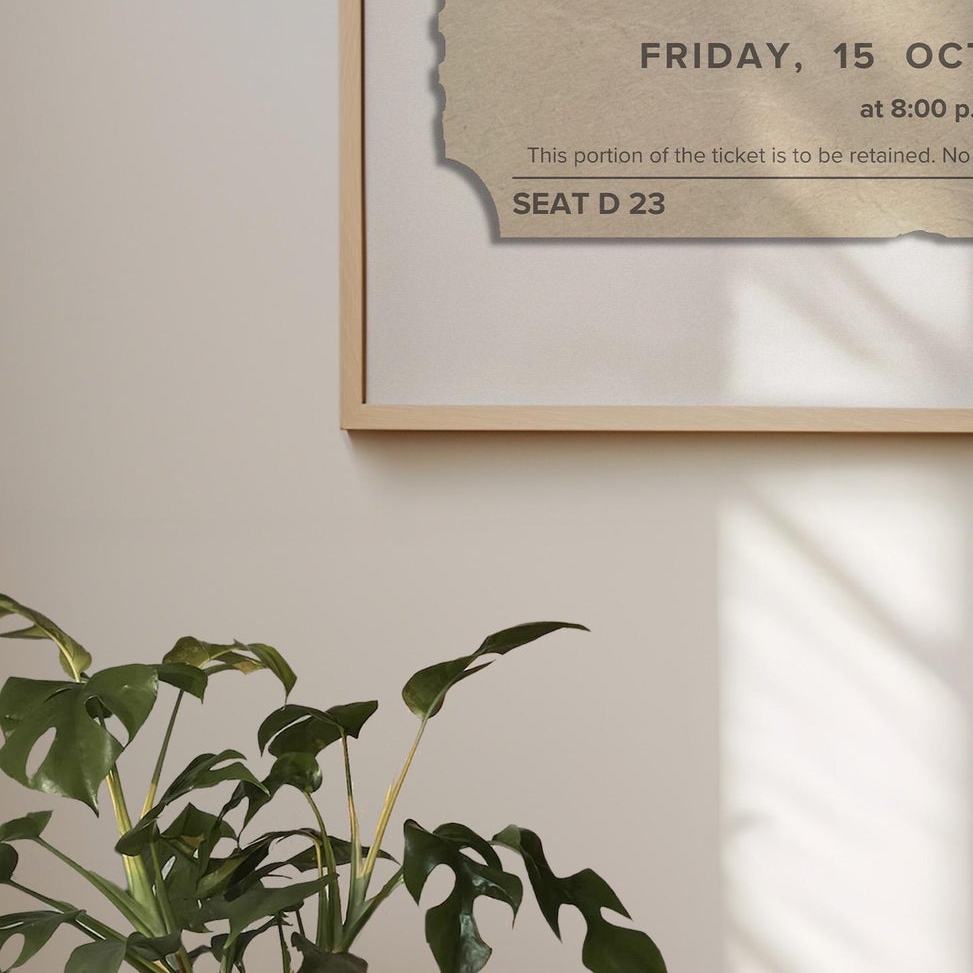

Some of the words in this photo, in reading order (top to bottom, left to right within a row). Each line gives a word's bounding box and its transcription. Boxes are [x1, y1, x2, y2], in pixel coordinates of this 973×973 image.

[640, 42, 803, 74] FRIDAY,
[832, 42, 875, 70] 15
[859, 99, 885, 119] at
[890, 98, 948, 119] 8:00
[526, 146, 568, 164] This
[574, 147, 643, 168] portion
[649, 146, 670, 164] of
[674, 146, 706, 164] the
[711, 146, 766, 164] ticket
[771, 146, 787, 164] is
[791, 147, 812, 164] to
[818, 146, 843, 164] be
[849, 146, 936, 164] retained.
[942, 146, 971, 164] No
[512, 191, 590, 216] SEAT
[598, 192, 621, 215] D
[629, 191, 666, 215] 23
